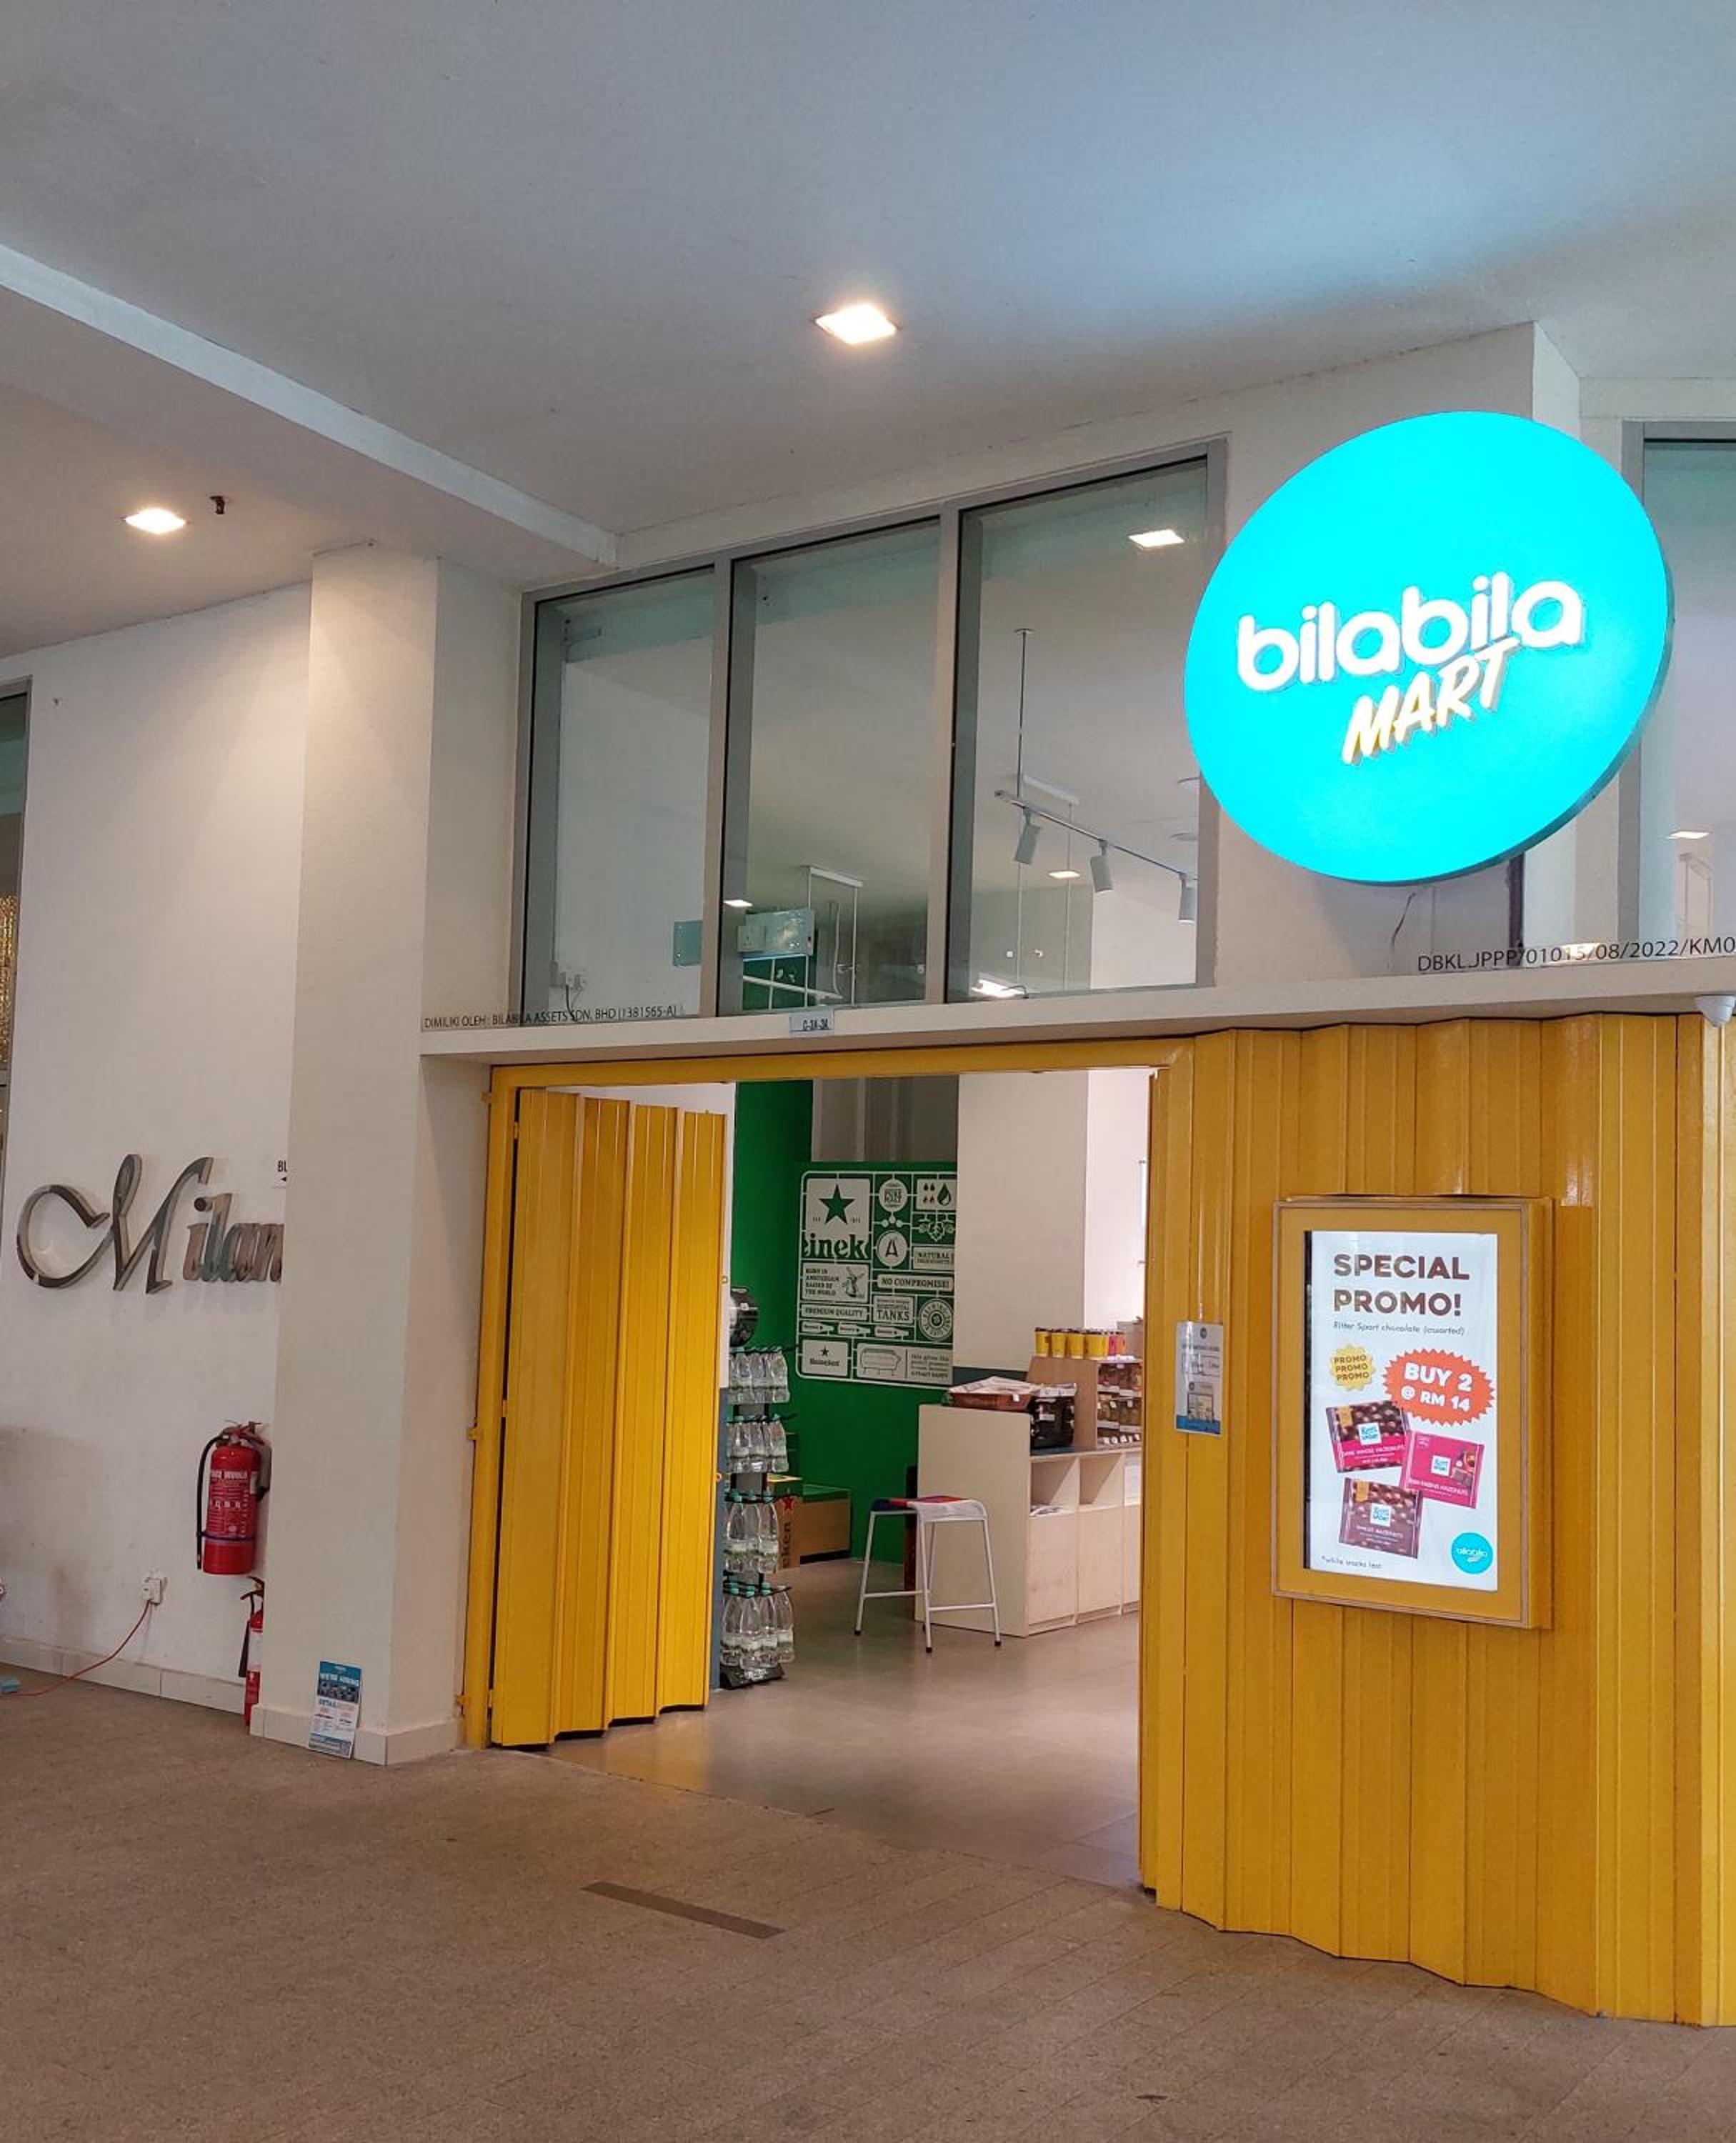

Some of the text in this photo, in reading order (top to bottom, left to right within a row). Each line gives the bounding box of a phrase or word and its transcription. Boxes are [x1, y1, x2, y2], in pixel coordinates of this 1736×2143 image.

[1237, 571, 1586, 691] bilabila
[1342, 636, 1520, 766] MART
[534, 1010, 568, 1023] ASSETS
[595, 1007, 617, 1019] BHD
[1334, 1254, 1470, 1281] SPECIAL
[877, 1309, 909, 1321] TANKS
[1334, 1289, 1462, 1317] PROMO!
[1334, 1354, 1367, 1364] PROMO
[1335, 1363, 1368, 1372] PROMO
[1337, 1372, 1370, 1380] PROMO
[1405, 1362, 1473, 1392] BUY 2
[1401, 1385, 1470, 1412] @ RM 14
